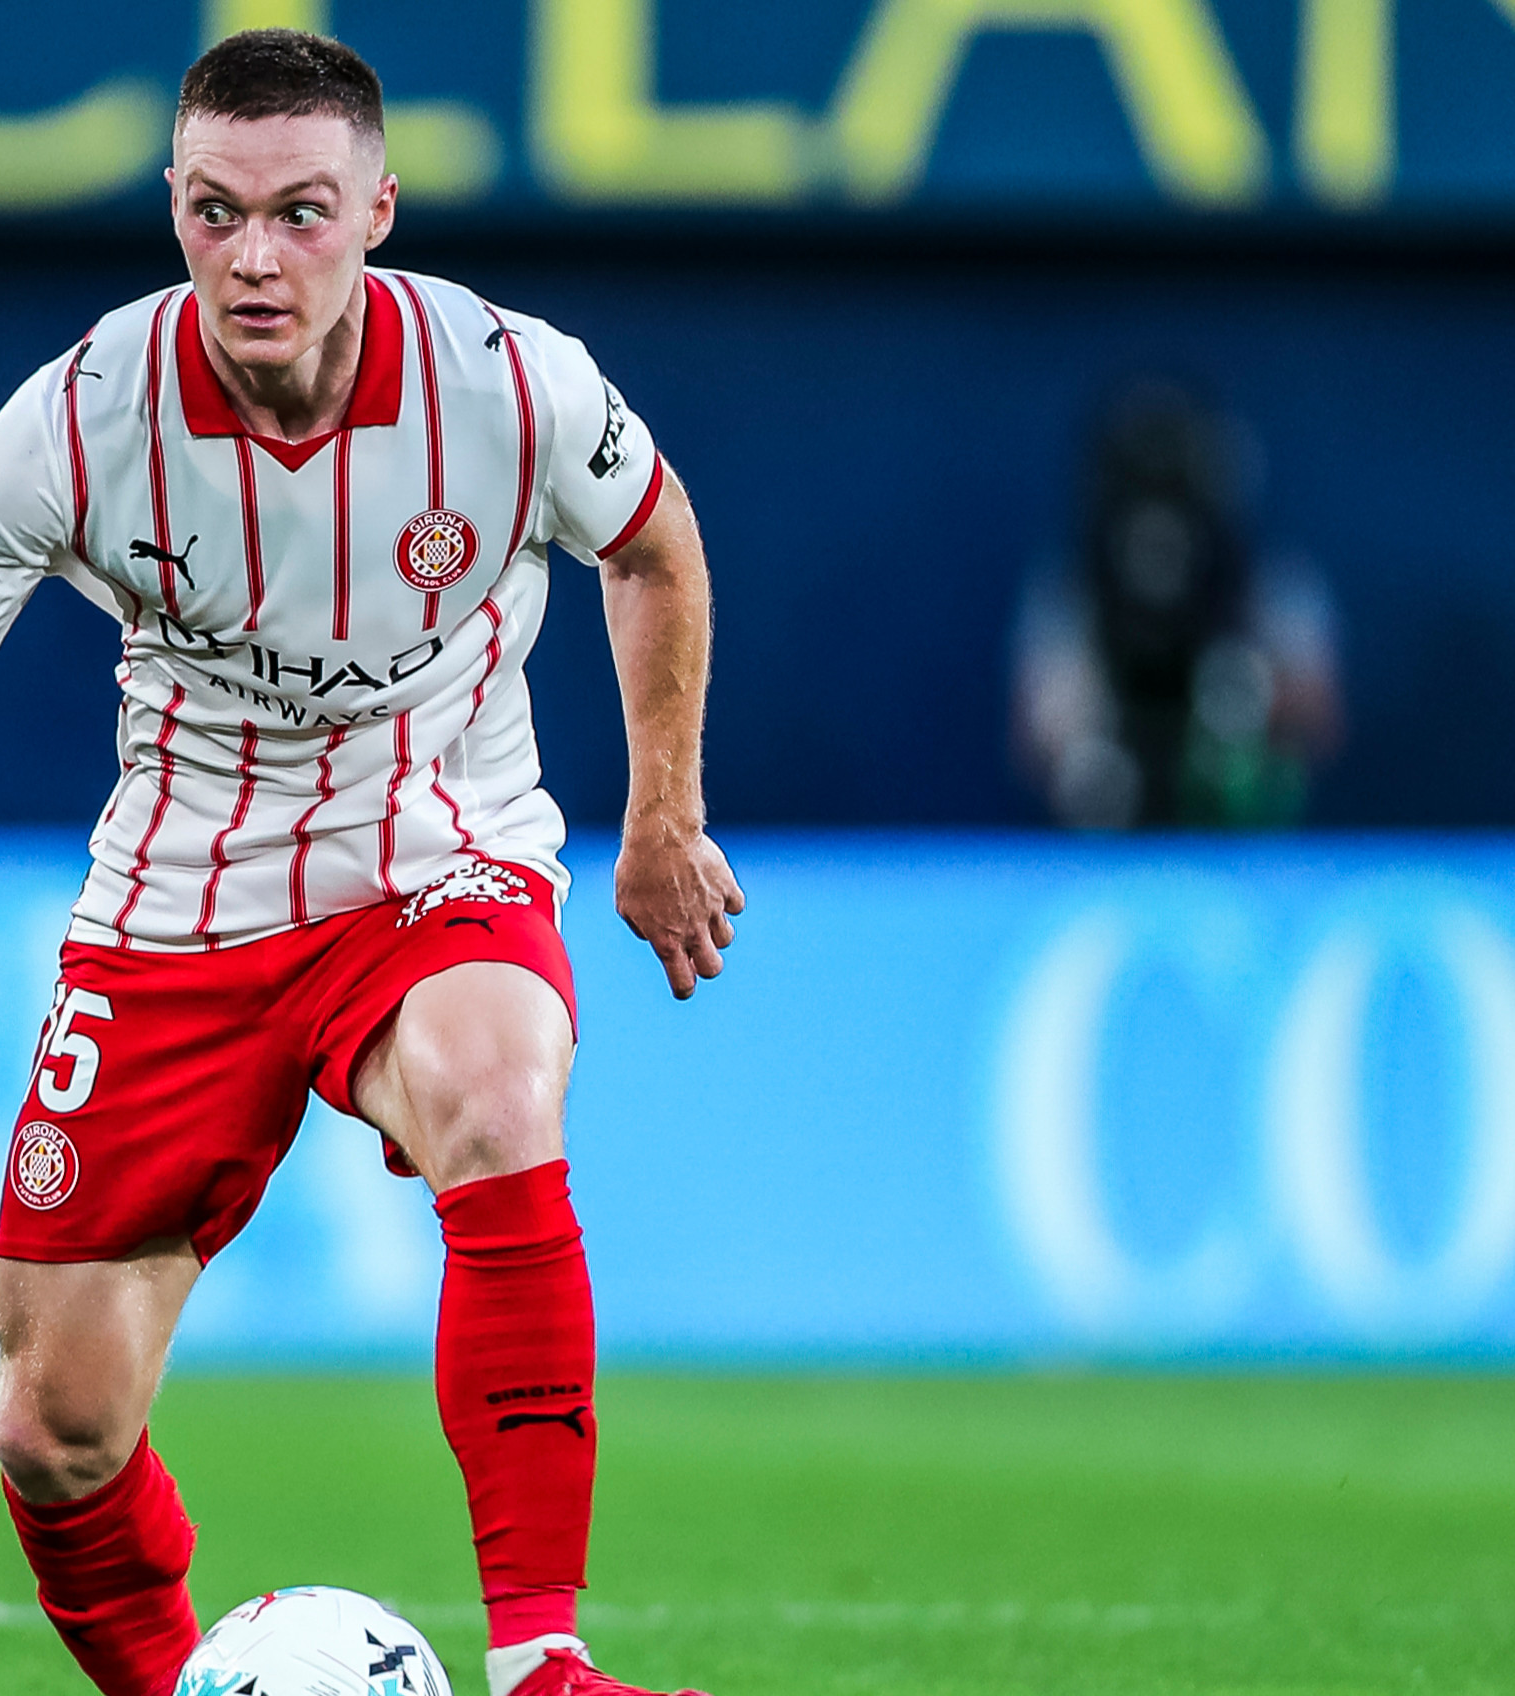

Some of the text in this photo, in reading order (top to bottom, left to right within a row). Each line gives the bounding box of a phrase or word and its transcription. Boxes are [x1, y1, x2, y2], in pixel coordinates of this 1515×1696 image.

[409, 513, 464, 533] GIRONA
[410, 568, 463, 586] FUTBOL CLUB
[22, 1125, 66, 1150] GIRONA
[18, 1184, 62, 1204] FUTBOL CLUB
